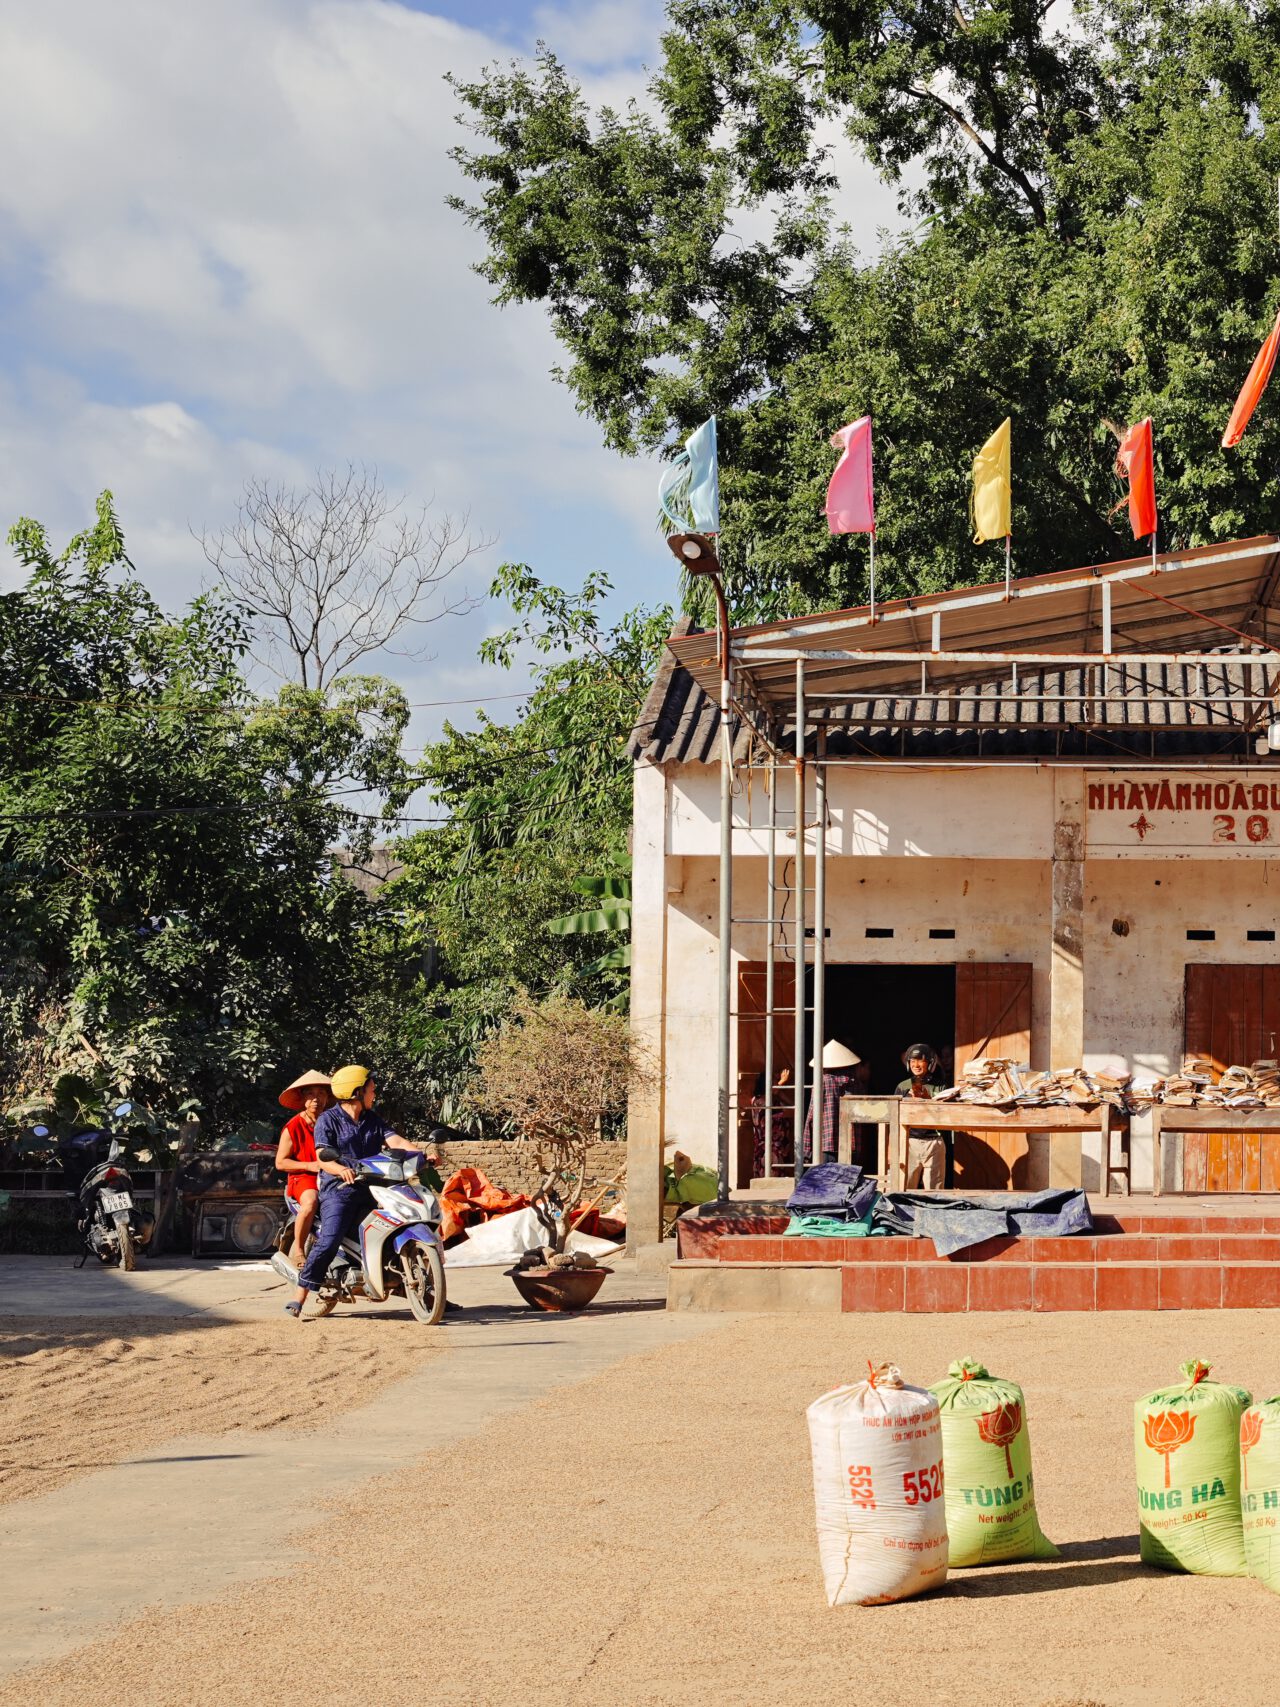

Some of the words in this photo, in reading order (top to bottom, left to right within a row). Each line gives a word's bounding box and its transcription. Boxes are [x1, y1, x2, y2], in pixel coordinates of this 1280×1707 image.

[848, 1464, 876, 1510] 552F
[960, 1480, 1023, 1507] TÙNG
[1191, 1476, 1226, 1504] HÀ
[978, 1513, 994, 1524] Net
[1182, 1512, 1192, 1523] 50
[1195, 1510, 1207, 1521] Kg
